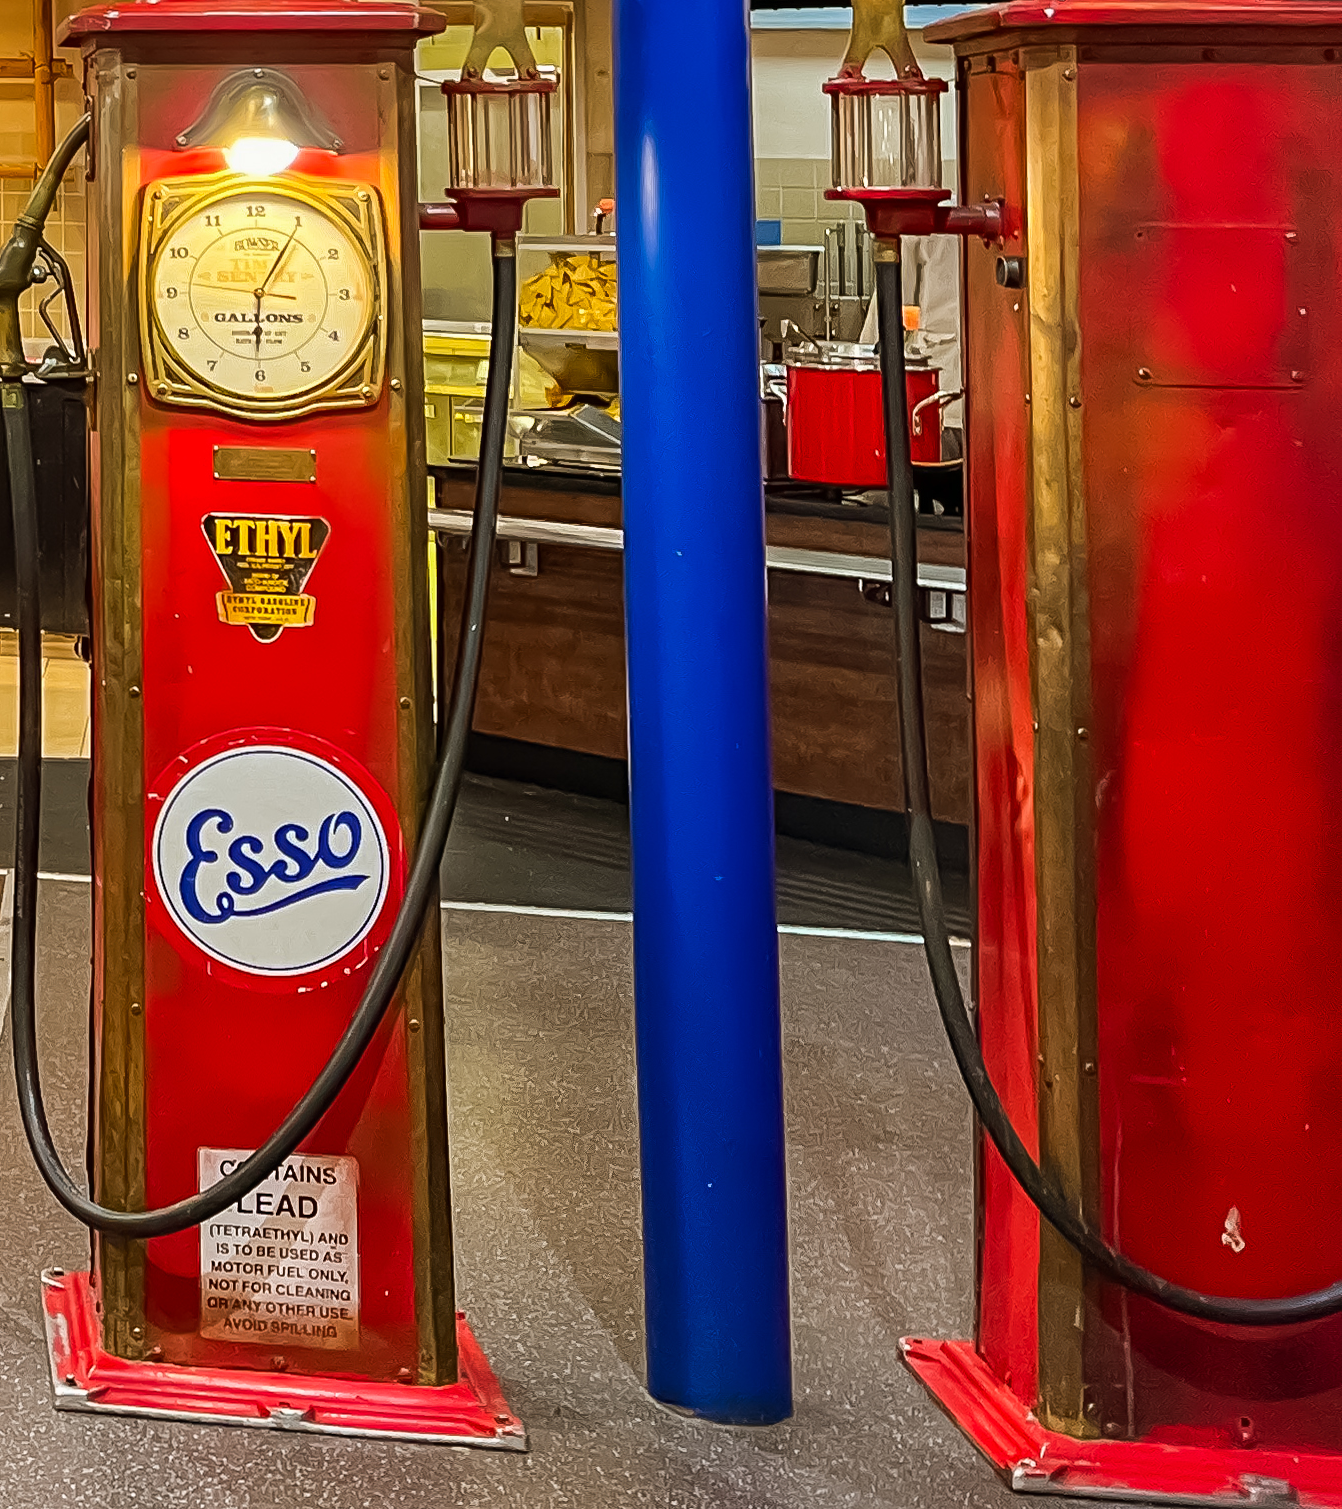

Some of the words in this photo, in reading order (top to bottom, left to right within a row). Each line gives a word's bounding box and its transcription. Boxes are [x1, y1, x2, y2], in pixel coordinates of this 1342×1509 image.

[246, 206, 265, 217] 12
[205, 215, 221, 226] 11
[294, 216, 303, 227] 1
[169, 247, 189, 258] 10
[327, 249, 339, 260] 2
[166, 287, 177, 298] 9
[339, 289, 350, 300] 3
[214, 313, 304, 323] GALLONS
[178, 328, 190, 339] 8
[328, 330, 340, 341] 4
[207, 360, 218, 371] 7
[300, 361, 311, 372] 5
[255, 370, 266, 381] 6
[215, 519, 317, 559] ETHYL
[179, 809, 370, 924] Esso
[219, 1159, 337, 1185] CTAINS
[236, 1192, 319, 1219] LEAD
[209, 1223, 314, 1245] (TETRAETHYL)
[318, 1232, 349, 1246] AND
[216, 1242, 229, 1255] IS
[233, 1243, 253, 1256] TO
[257, 1245, 276, 1258] BE
[279, 1247, 319, 1261] USED
[323, 1251, 343, 1264] AS
[211, 1260, 264, 1276] MOTOR
[267, 1264, 304, 1279] FUEL
[208, 1278, 238, 1291] NOT
[242, 1280, 272, 1294] FOR
[275, 1284, 351, 1302] CLEANING
[207, 1296, 228, 1309] OR
[232, 1298, 261, 1313] ANY
[265, 1301, 315, 1318] OTHER
[319, 1306, 351, 1320] USE
[223, 1317, 268, 1332] AVOID
